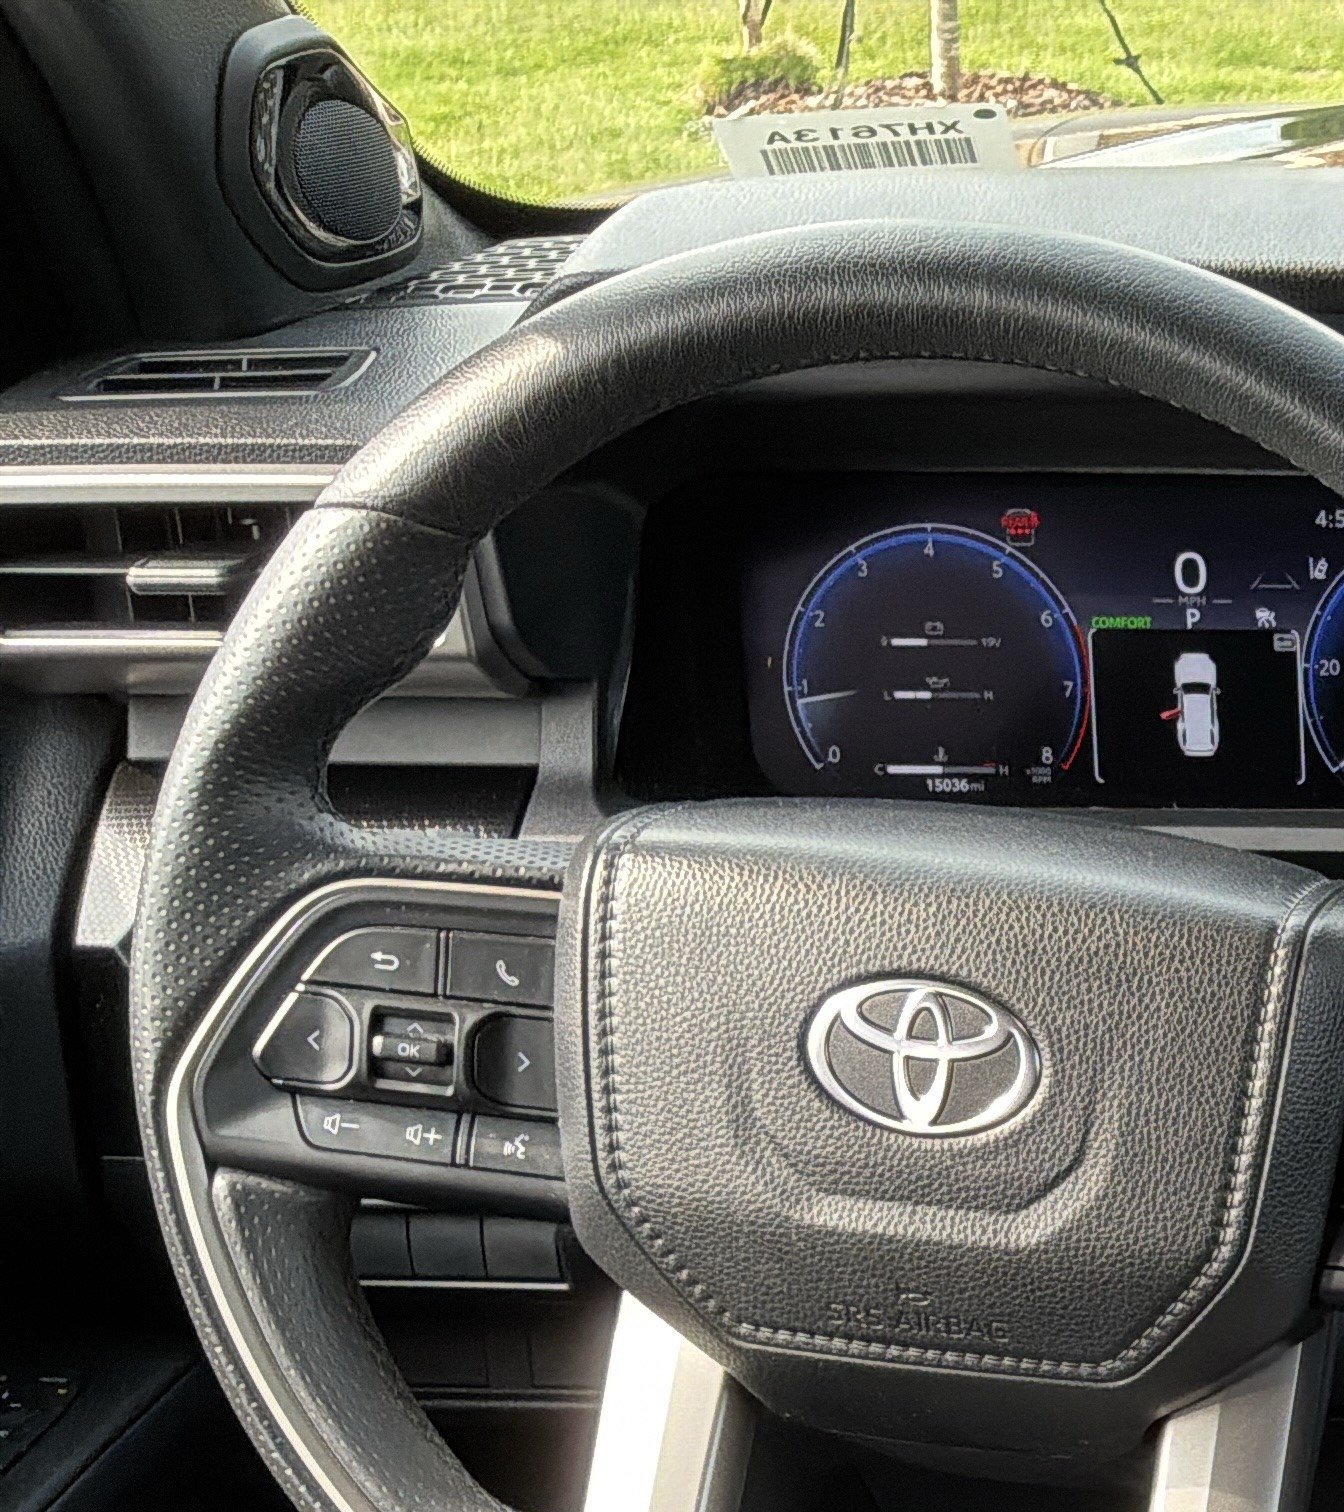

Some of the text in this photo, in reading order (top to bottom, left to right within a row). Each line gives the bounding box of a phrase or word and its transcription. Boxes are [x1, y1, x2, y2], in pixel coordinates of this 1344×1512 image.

[857, 562, 869, 579] 3
[991, 562, 1004, 579] 5
[1173, 551, 1208, 595] 0
[1178, 595, 1208, 606] MPH
[813, 610, 826, 629] 2
[1040, 610, 1054, 629] 6
[1091, 616, 1153, 630] COMFORT
[1185, 610, 1201, 629] P
[1318, 658, 1342, 677] 20
[983, 690, 994, 701] H
[1062, 680, 1075, 698] 7
[828, 745, 841, 763] 0
[1040, 746, 1054, 764] 8
[874, 763, 1009, 776] C H
[397, 1043, 420, 1057] OK
